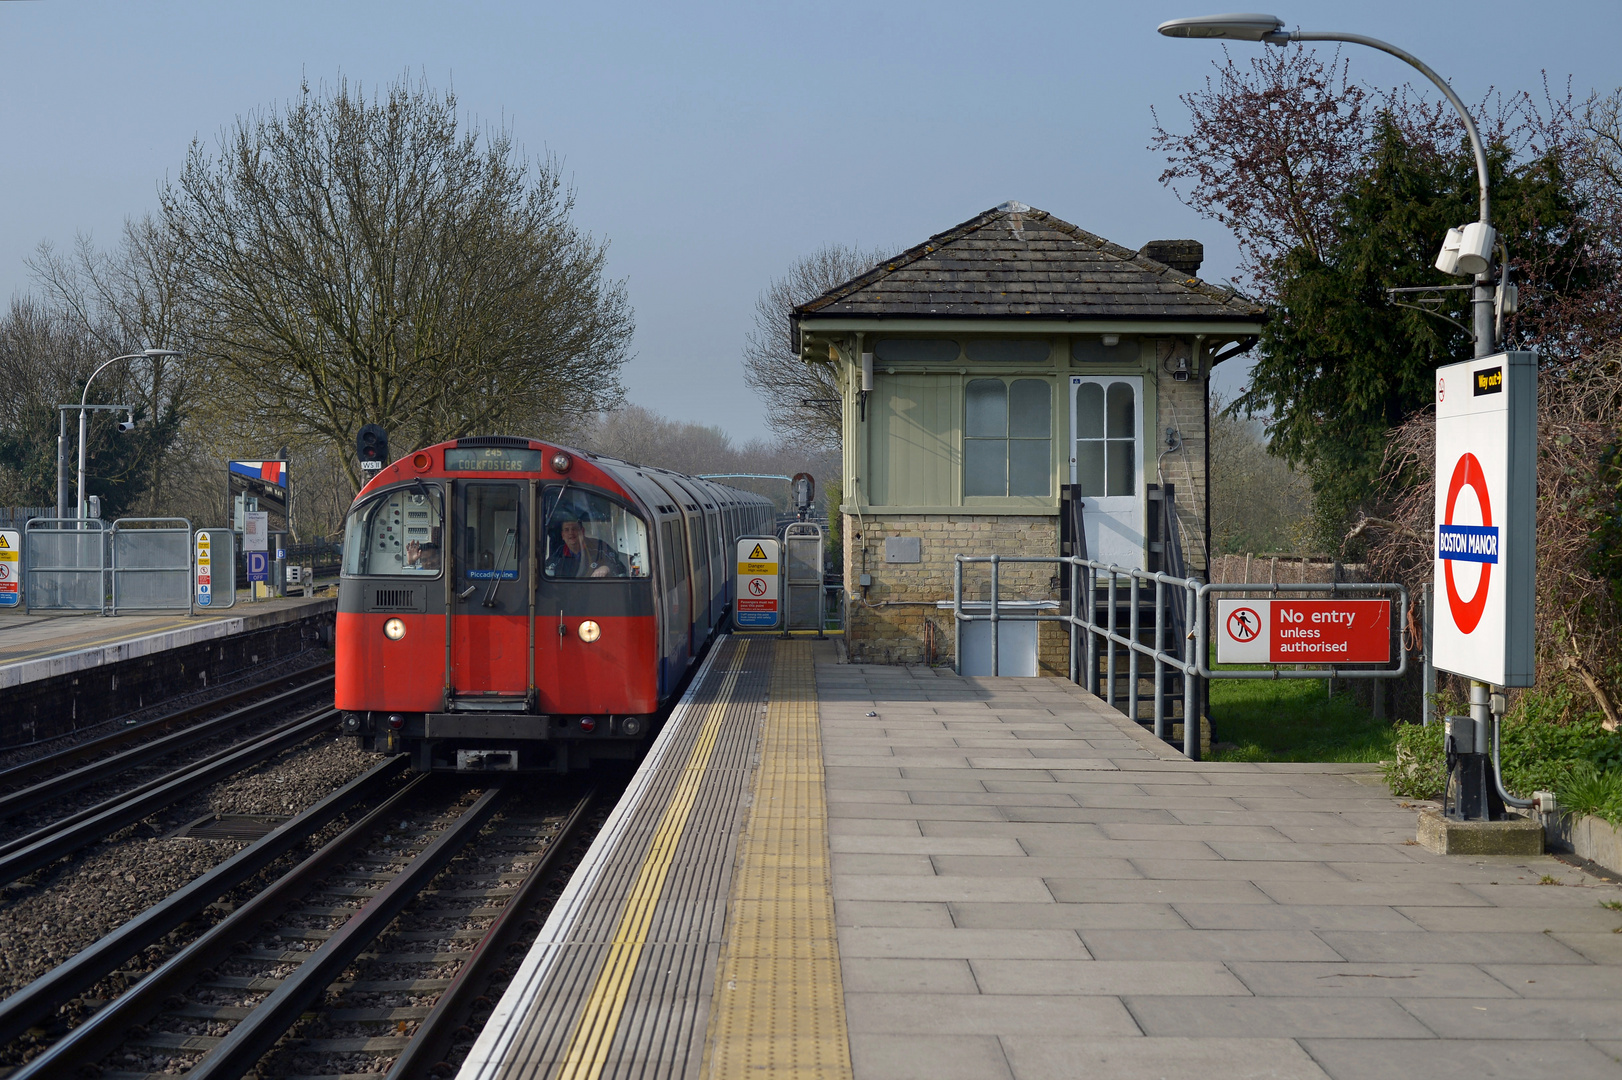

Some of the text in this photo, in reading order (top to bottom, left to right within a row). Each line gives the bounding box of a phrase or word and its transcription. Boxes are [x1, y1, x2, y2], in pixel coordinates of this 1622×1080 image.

[1478, 373, 1497, 390] Way out
[486, 448, 502, 456] 245
[458, 460, 522, 470] COCKFOSTERS
[1440, 532, 1498, 556] BOSTON MANOR
[252, 554, 265, 572] D
[1280, 608, 1356, 626] No entry
[1280, 627, 1321, 638] unless
[1280, 641, 1348, 652] authorised
